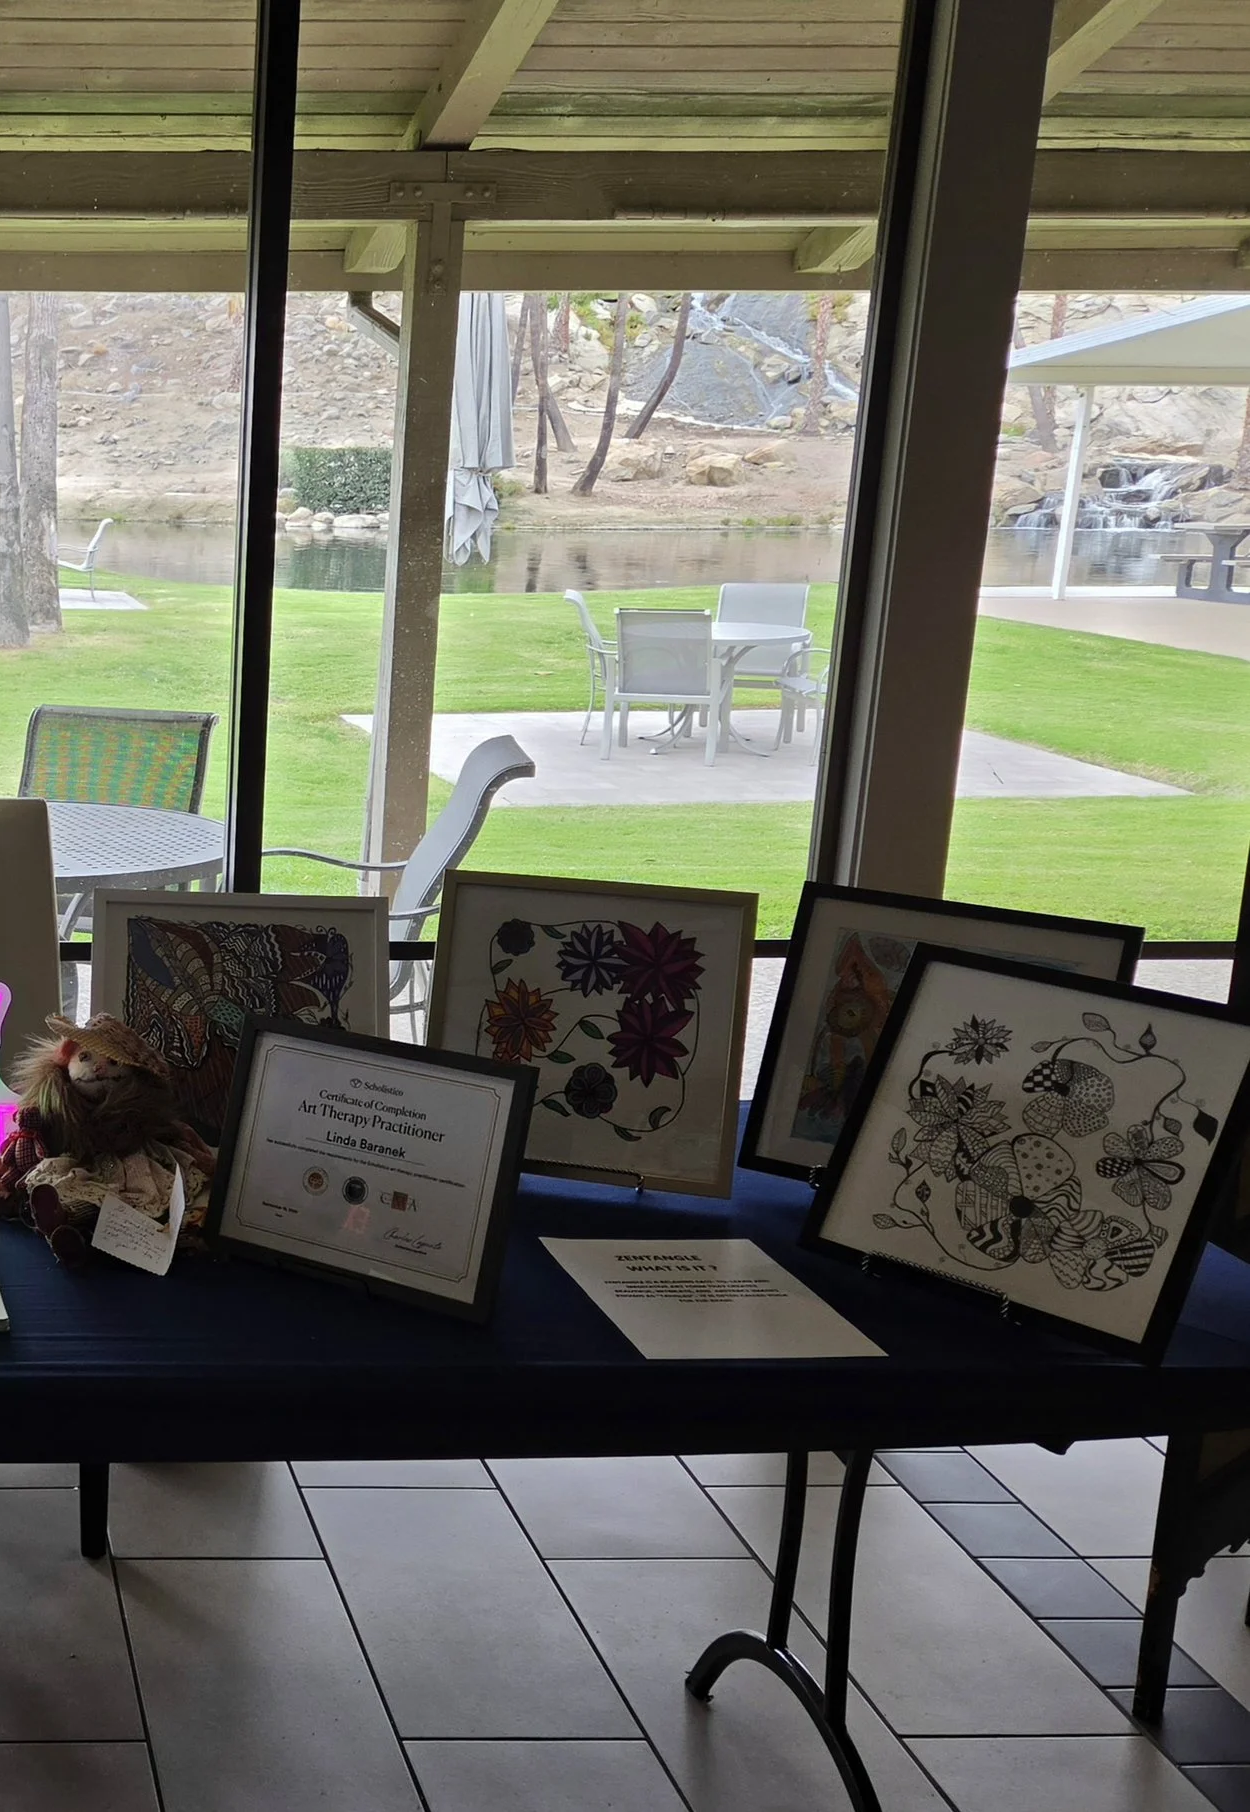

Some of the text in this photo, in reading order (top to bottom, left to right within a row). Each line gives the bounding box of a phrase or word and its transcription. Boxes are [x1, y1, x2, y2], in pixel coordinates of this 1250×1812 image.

[298, 1099, 446, 1143] Art Therapy Practitioner
[319, 1089, 427, 1121] Certificate of Completion
[326, 1130, 357, 1148] Linda
[359, 1138, 406, 1159] Baranek
